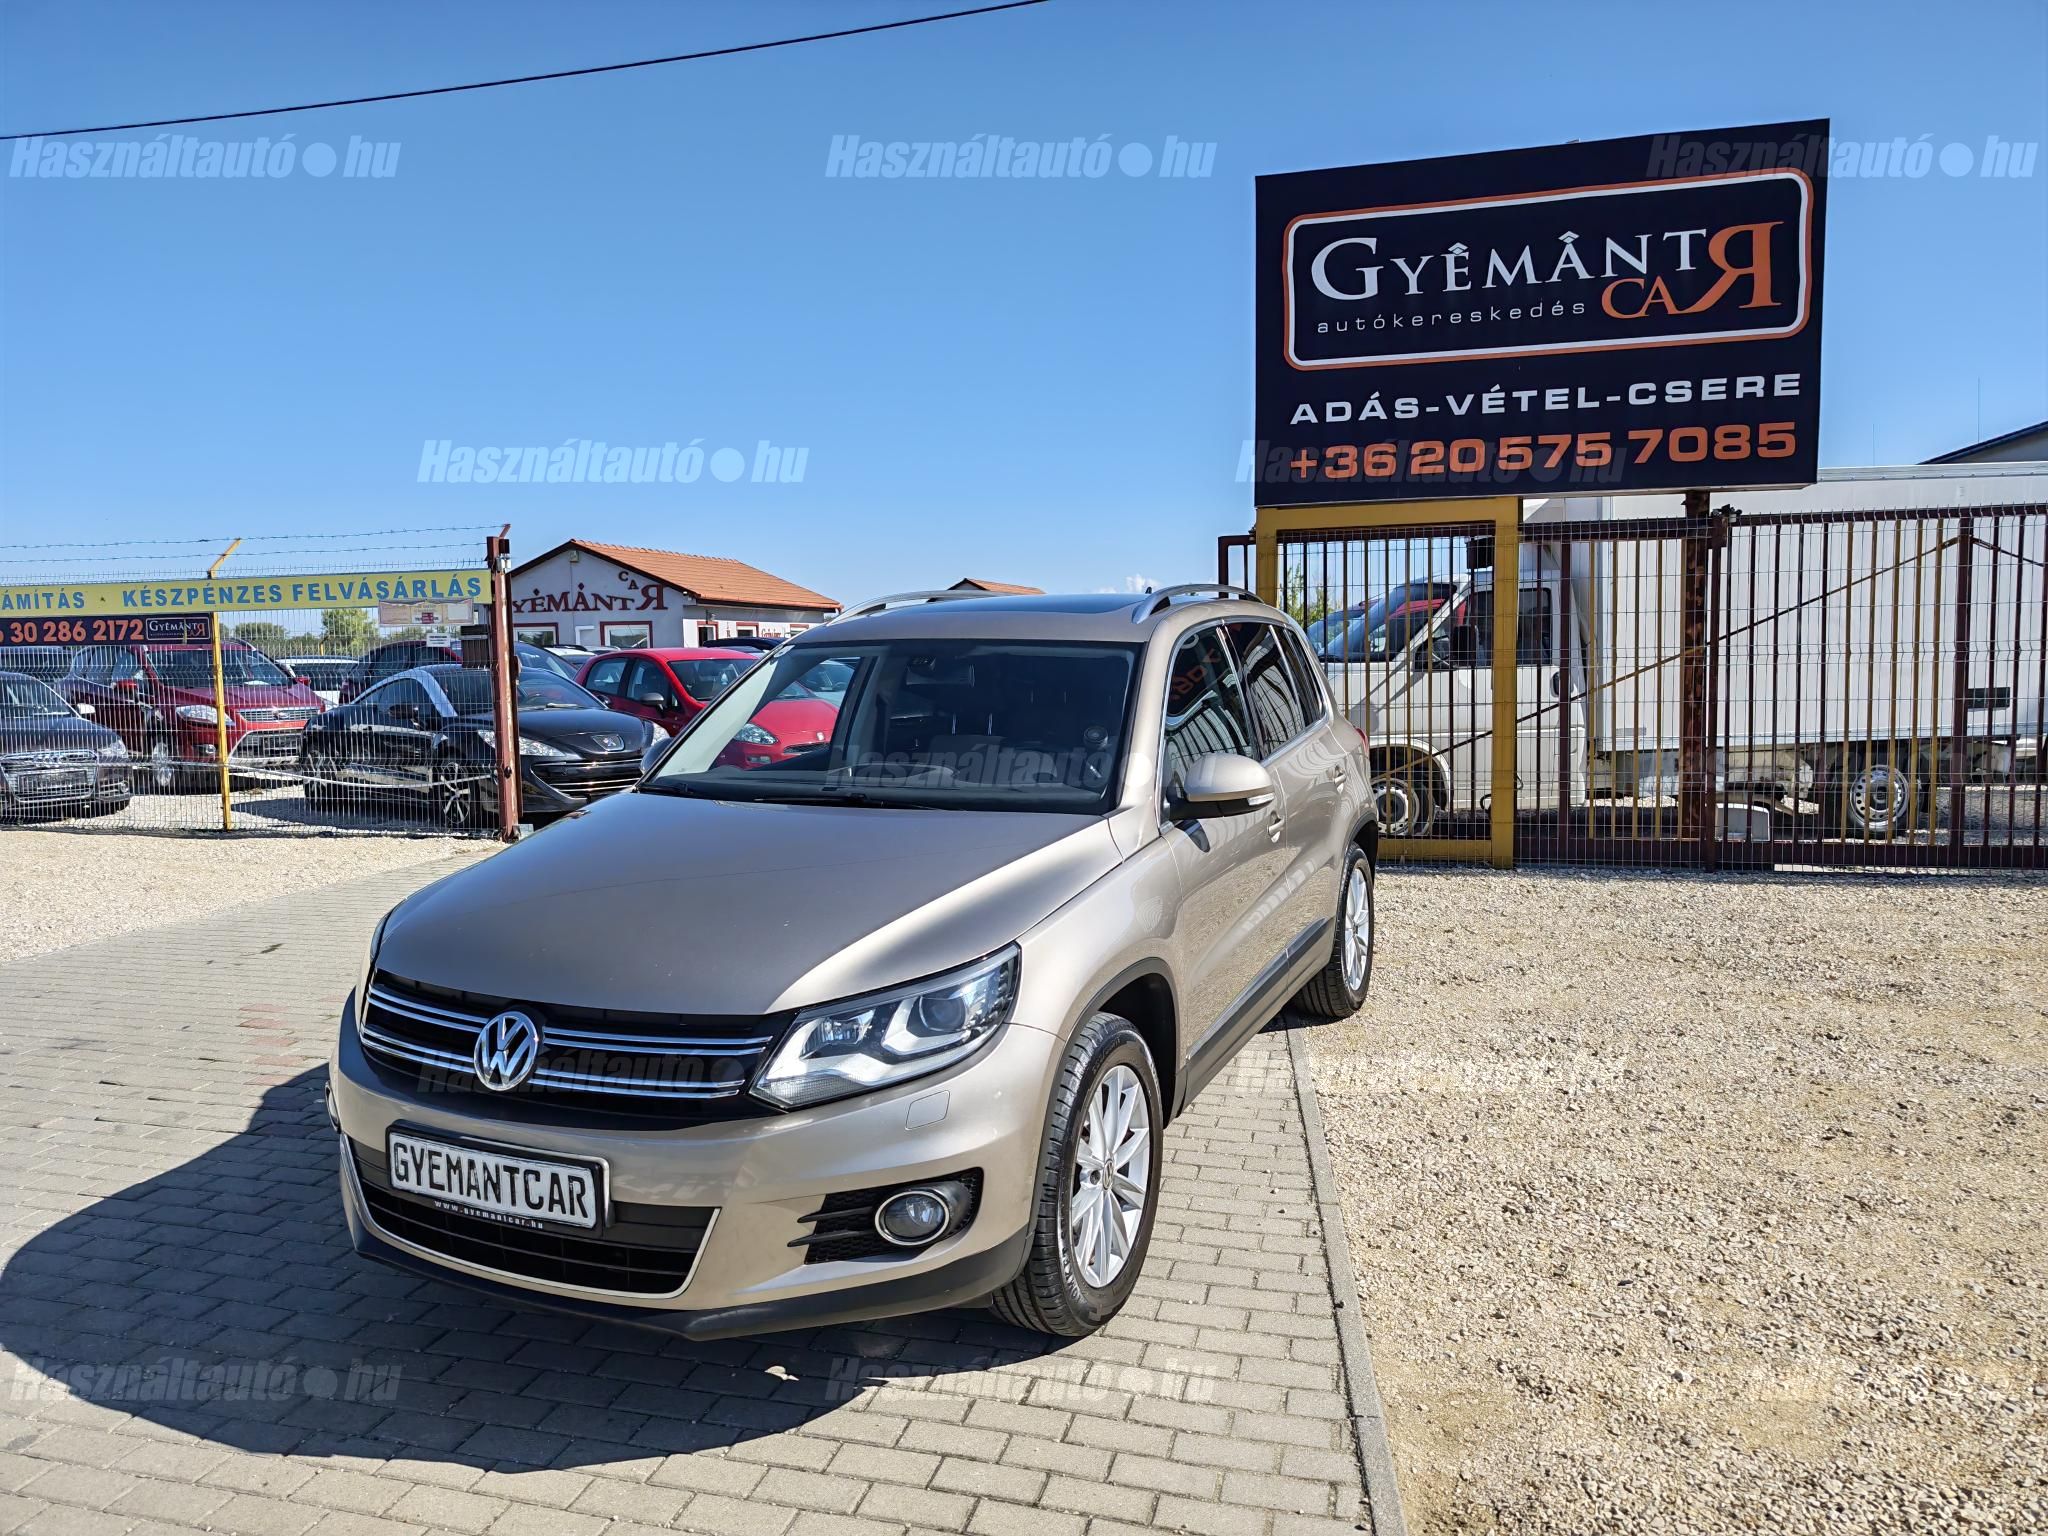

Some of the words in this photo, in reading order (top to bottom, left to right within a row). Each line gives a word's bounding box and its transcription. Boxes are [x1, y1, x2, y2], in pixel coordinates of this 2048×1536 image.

[1317, 300, 1585, 334] autókereskedés
[1290, 373, 1800, 425] ADÁS-VÉTEL-CSERE
[1628, 422, 1796, 464] 7085
[122, 583, 282, 608] KÉSZPÉNZES
[292, 574, 482, 602] FELVÁSÁRLÁS
[10, 621, 38, 643] 30
[43, 620, 87, 642] 286
[92, 618, 145, 641] 2172
[393, 1142, 589, 1219] GYEMANTCAR
